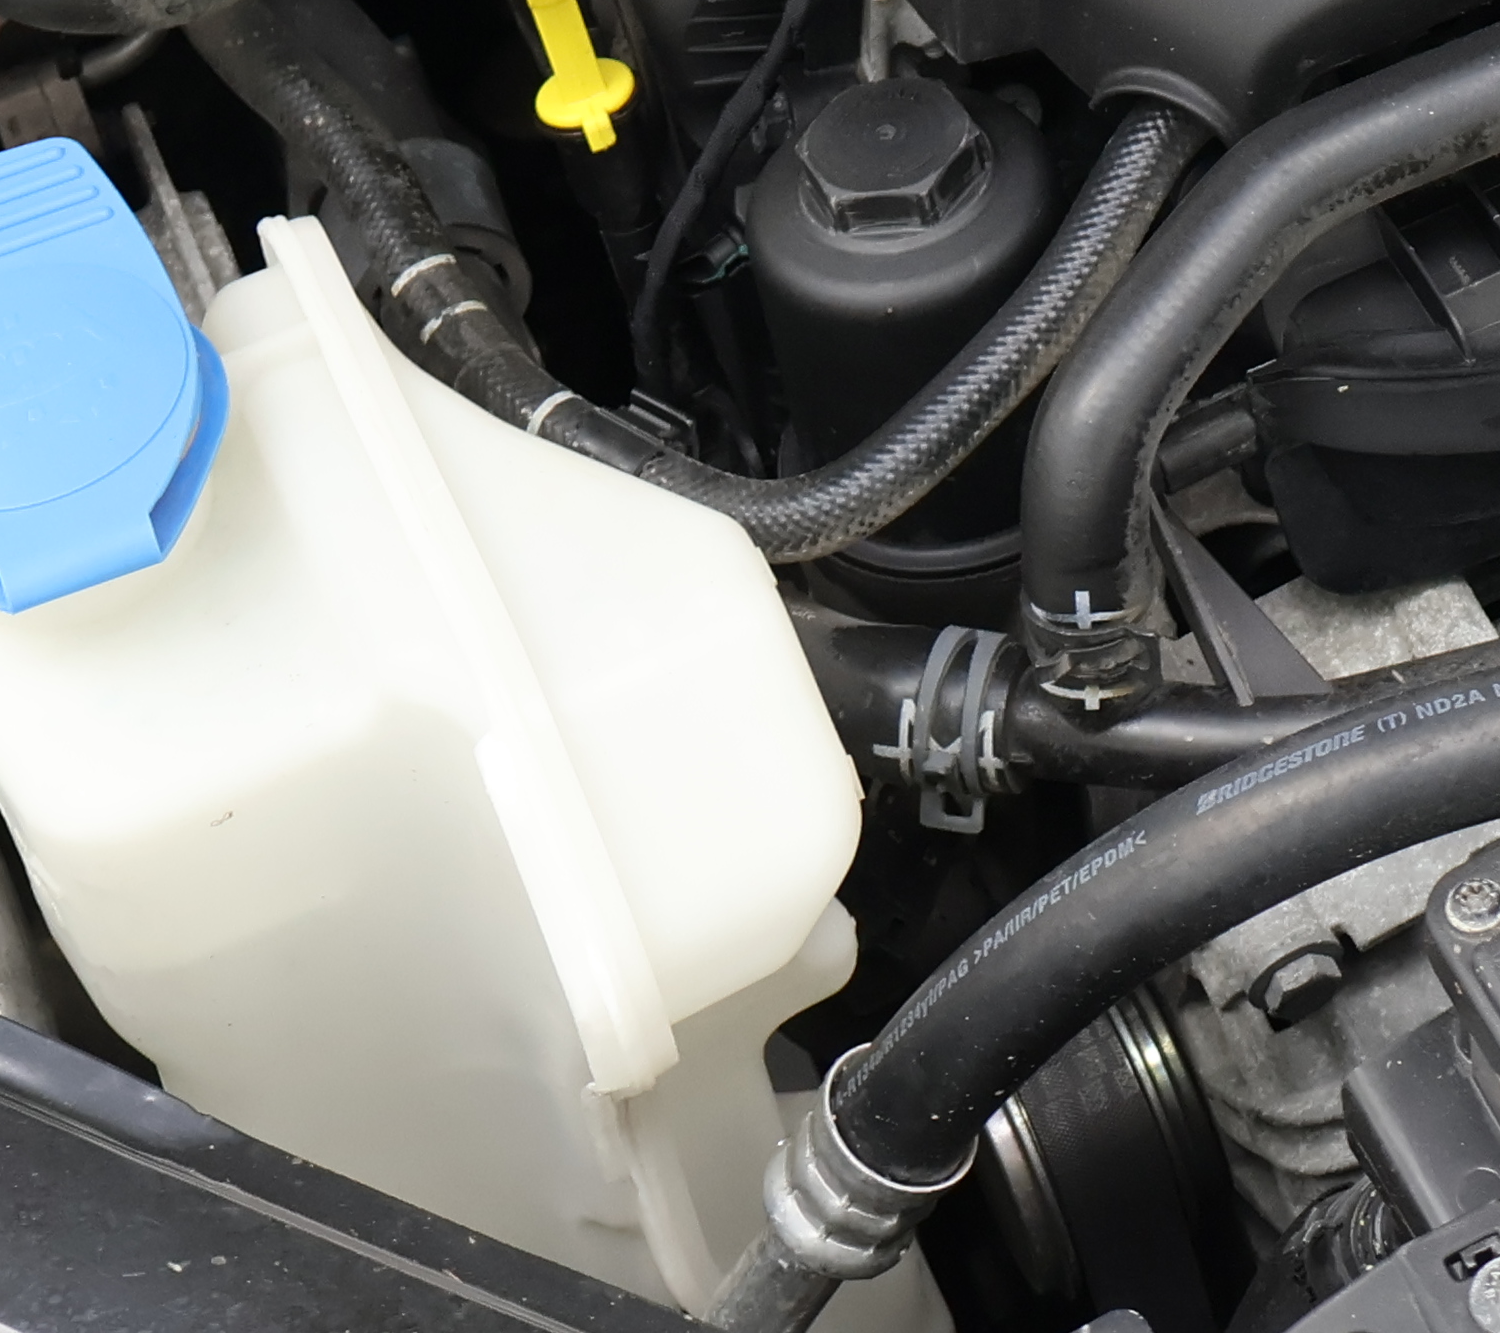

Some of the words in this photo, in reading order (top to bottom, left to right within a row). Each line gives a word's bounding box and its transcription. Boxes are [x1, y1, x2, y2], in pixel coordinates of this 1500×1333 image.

[1196, 724, 1365, 816] BRIDGESTONE
[1377, 710, 1408, 734] (T)
[1415, 690, 1487, 720] ND2A
